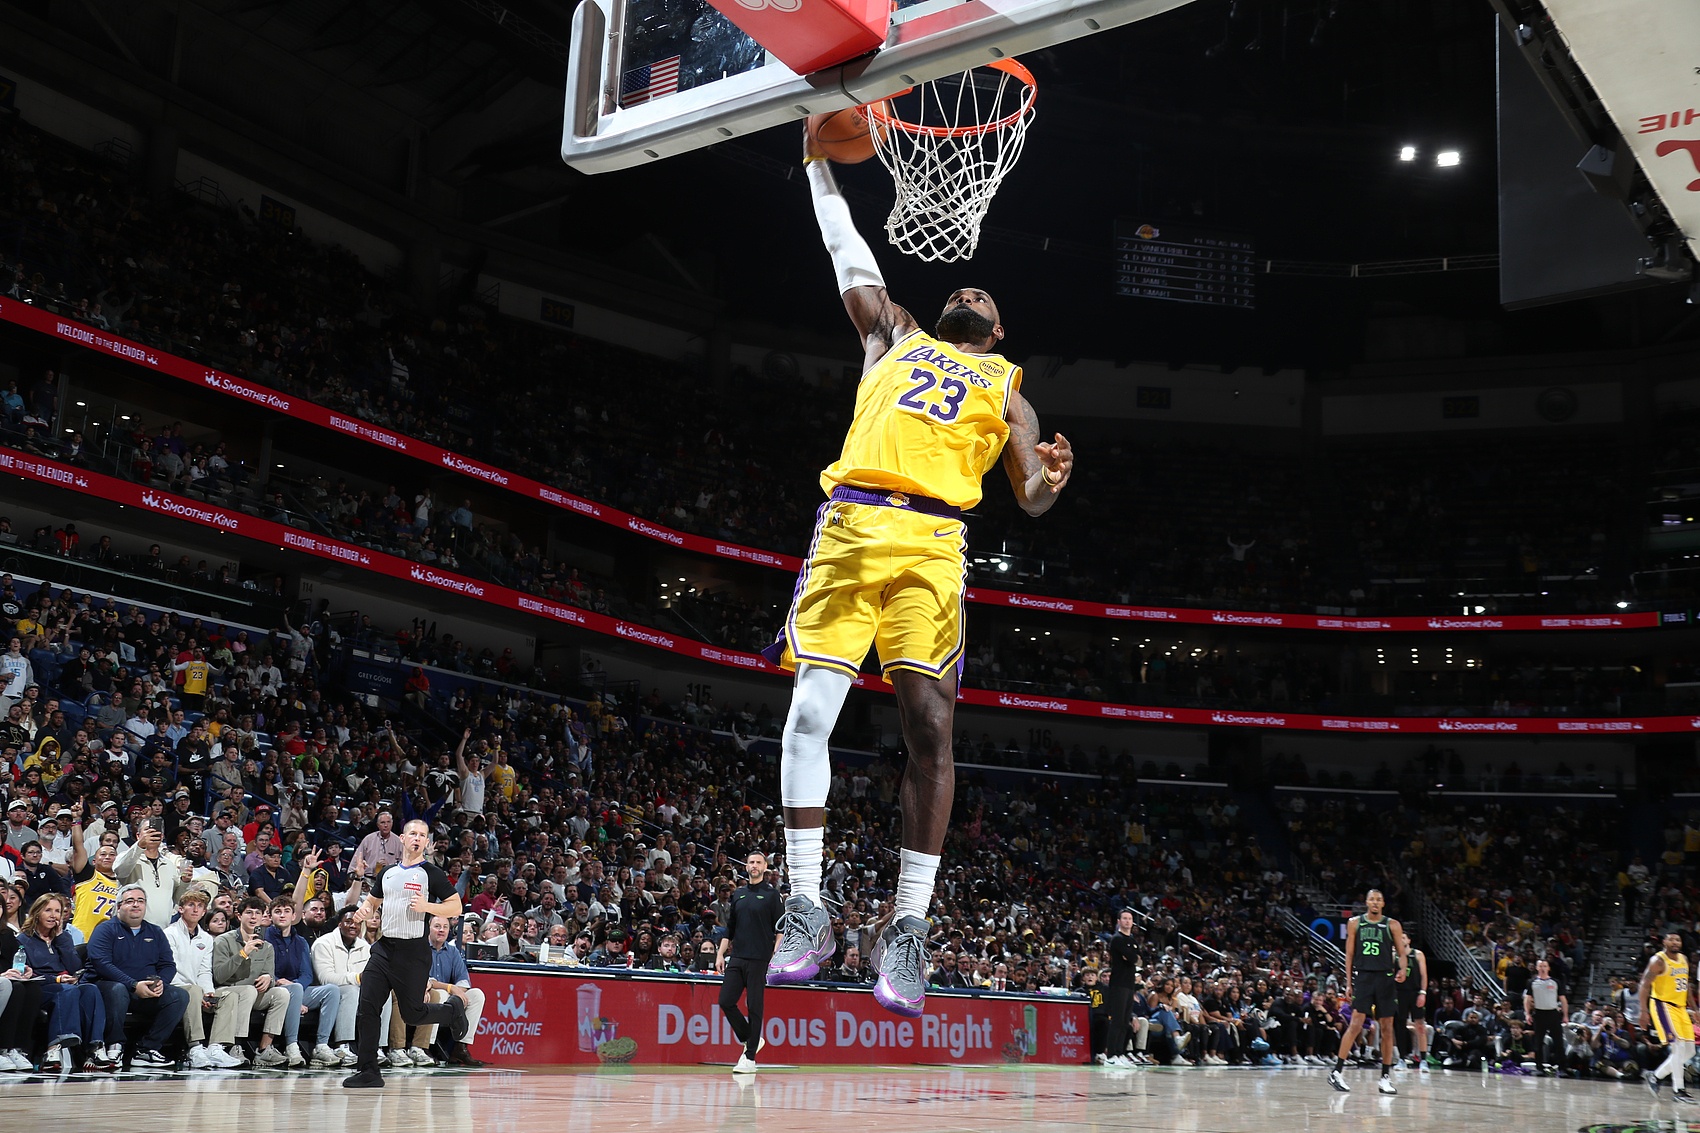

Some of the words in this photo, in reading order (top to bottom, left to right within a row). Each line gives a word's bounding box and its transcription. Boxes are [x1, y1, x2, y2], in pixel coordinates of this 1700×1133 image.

[264, 202, 292, 226] 318
[544, 303, 571, 321] 319
[58, 323, 94, 344] WELCOME
[113, 342, 145, 362] BLENDER
[896, 346, 992, 388] LAKERS
[982, 362, 1003, 374] bibigo
[222, 379, 267, 402] SMOOTHIE
[898, 368, 968, 421] 23
[330, 416, 358, 434] WELCOME
[372, 430, 396, 446] BLENDER
[16, 458, 24, 469] TO
[24, 462, 36, 473] THE
[36, 464, 74, 484] BLENDER
[455, 460, 491, 480] SMOOTHIE
[540, 488, 562, 503] WELCOME
[572, 500, 592, 514] BLENDER
[161, 499, 212, 522] SMOOTHIE
[638, 523, 668, 541] SMOOTHIE
[284, 532, 315, 550] WELCOME
[332, 545, 360, 562] BLENDER
[716, 545, 740, 557] WELCOME
[752, 553, 774, 564] BLENDER
[302, 582, 312, 593] 114
[425, 572, 464, 590] SMOOTHIE
[518, 598, 543, 612] WELCOME
[555, 608, 576, 622] BLENDER
[1022, 598, 1056, 609] SMOOTHIE
[1226, 614, 1263, 624] SMOOTHIE
[1443, 619, 1480, 628] SMOOTHIE
[412, 618, 436, 644] 114
[627, 627, 658, 644] SMOOTHIE
[358, 671, 372, 679] GREY
[373, 675, 392, 684] GOOSE
[1013, 696, 1050, 709] SMOOTHIE
[1226, 714, 1264, 724] SMOOTHIE
[1452, 721, 1494, 730] SMOOTHIE
[1028, 728, 1052, 749] 116
[91, 882, 119, 896] LAKE
[1360, 928, 1384, 943] NOLA
[1362, 942, 1380, 956] 25
[476, 1017, 542, 1036] SMOOTHIE
[836, 1012, 914, 1048] Done
[922, 1013, 993, 1058] Right
[1054, 1032, 1084, 1046] SMOOTHIE
